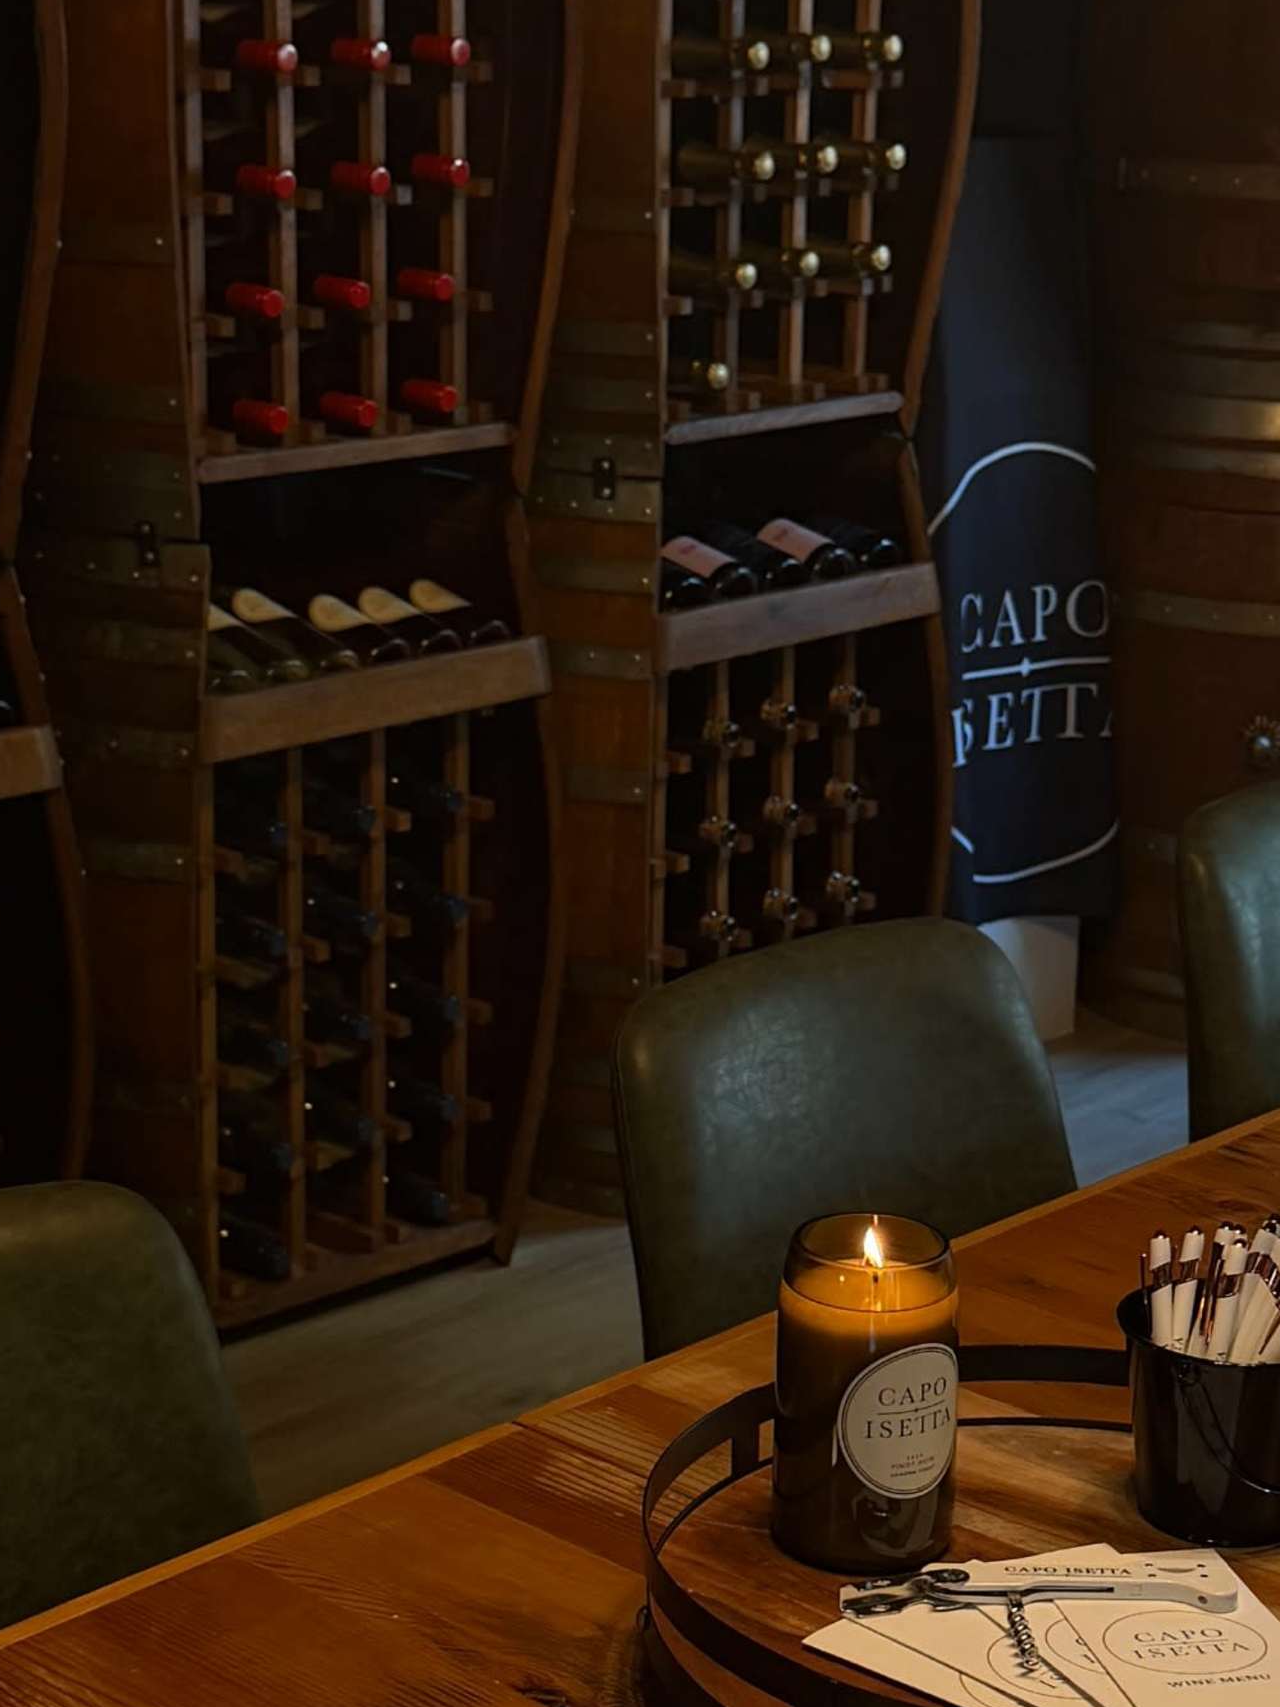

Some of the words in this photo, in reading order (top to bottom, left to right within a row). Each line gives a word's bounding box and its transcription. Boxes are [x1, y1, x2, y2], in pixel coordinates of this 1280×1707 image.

[959, 579, 1111, 655] CAPO
[951, 681, 1114, 769] ISETT
[878, 1376, 948, 1407] CAPO
[865, 1406, 951, 1439] ISETTA
[1003, 1566, 1058, 1574] CAPO
[1065, 1567, 1133, 1575] ISETTA
[1133, 1628, 1223, 1643] CAPO
[1133, 1642, 1250, 1660] ISETTA
[1167, 1678, 1216, 1688] WINE
[1219, 1673, 1271, 1683] MENU
